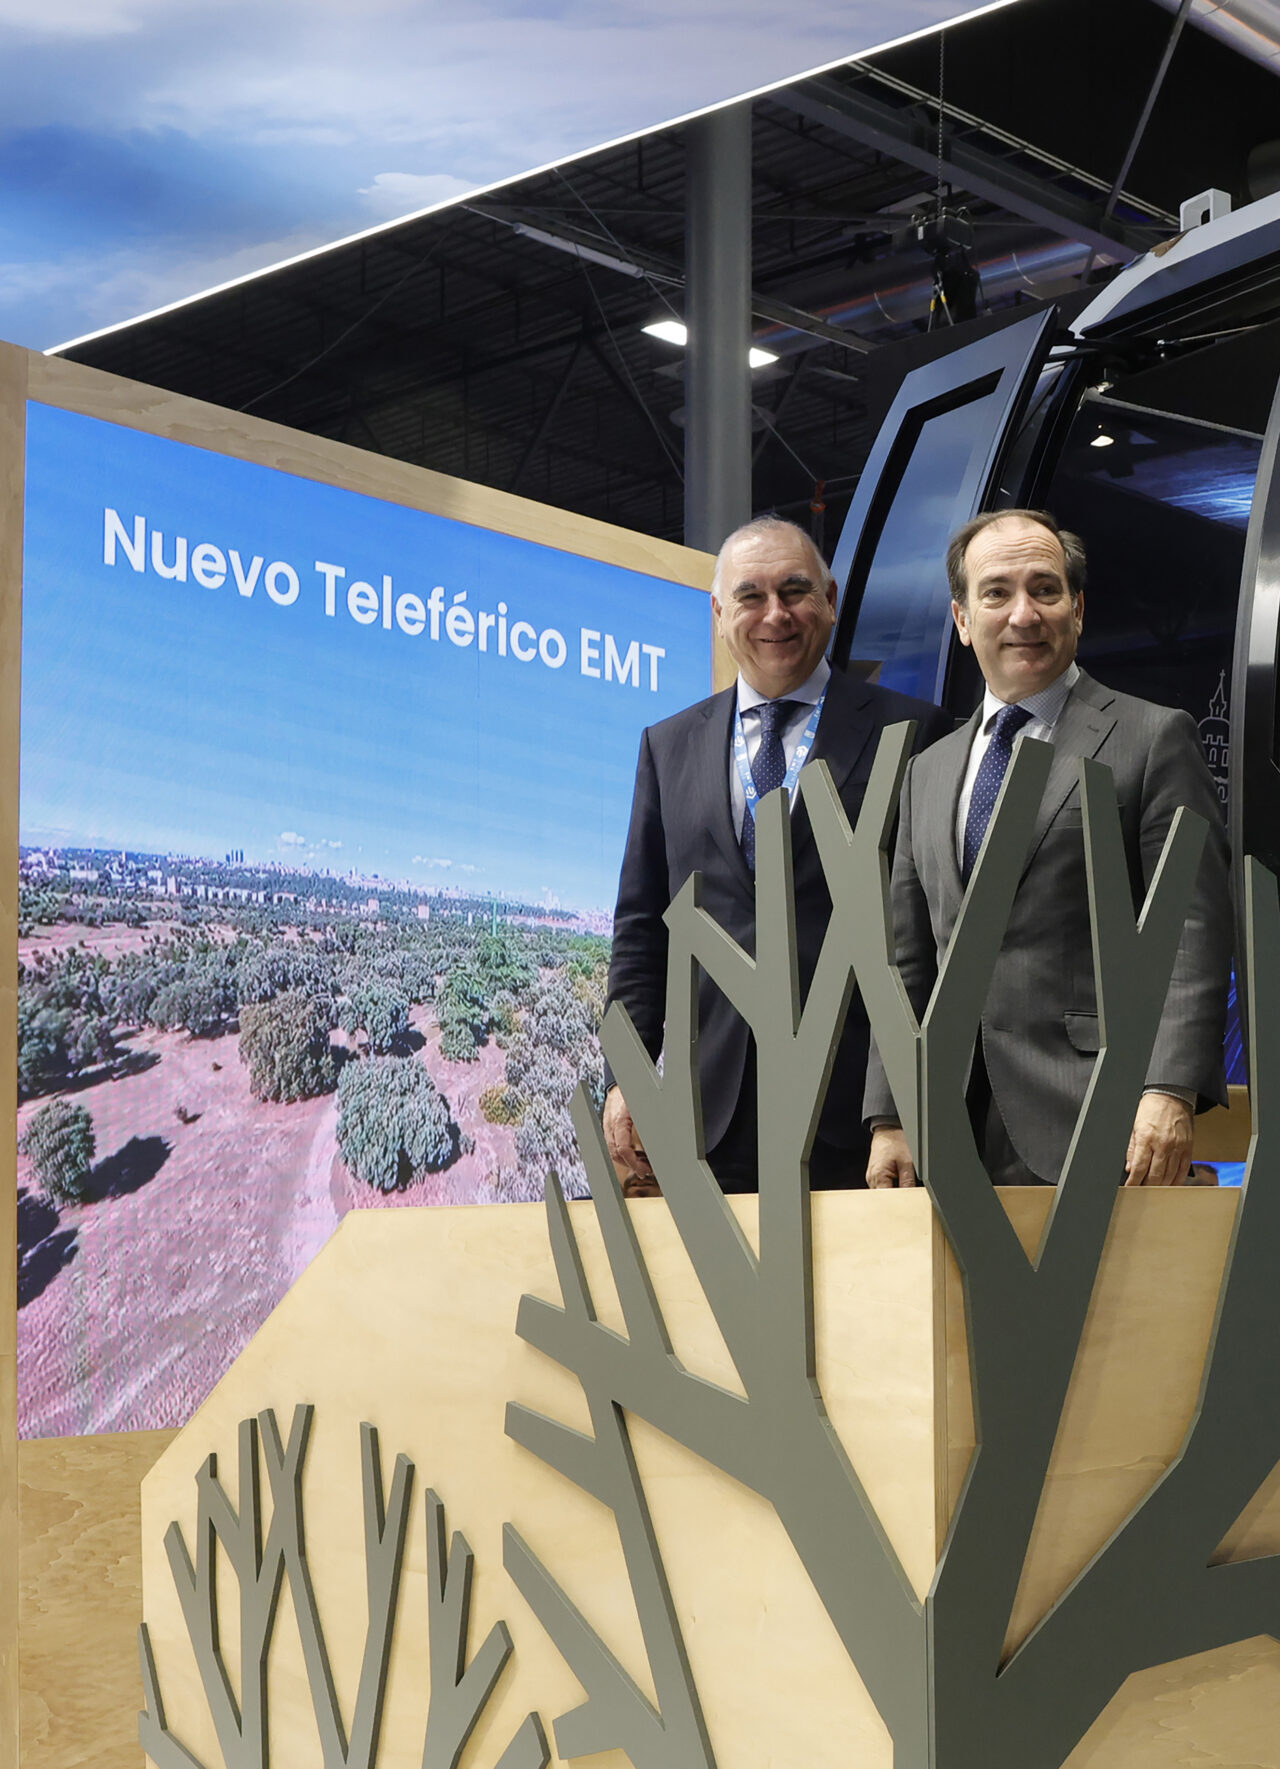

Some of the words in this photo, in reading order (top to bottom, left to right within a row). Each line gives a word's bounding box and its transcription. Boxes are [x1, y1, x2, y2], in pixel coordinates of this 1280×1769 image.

[103, 507, 300, 606] Nuevo
[314, 560, 568, 670] Teleférico
[580, 628, 666, 692] EMT
